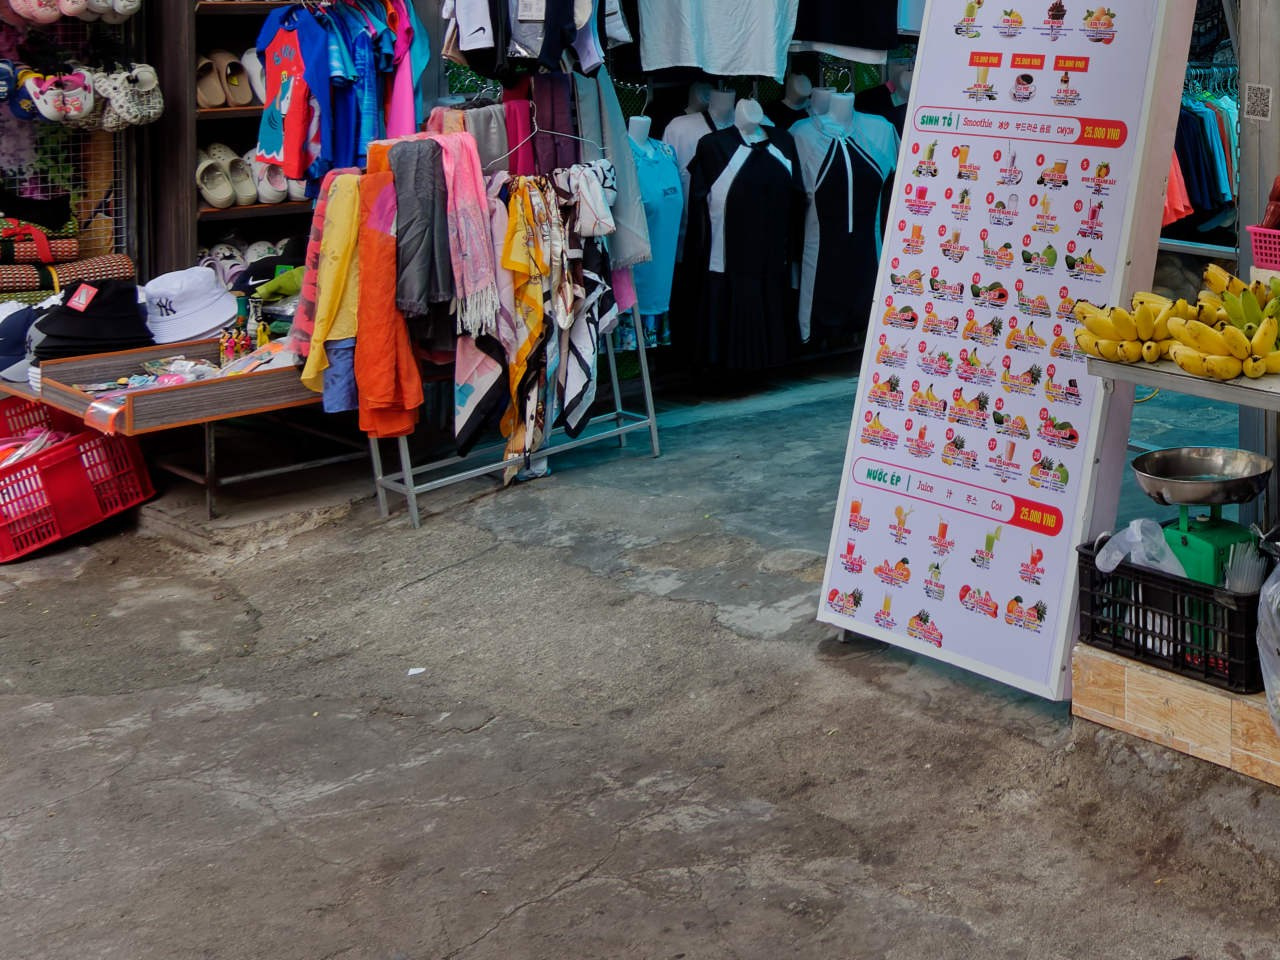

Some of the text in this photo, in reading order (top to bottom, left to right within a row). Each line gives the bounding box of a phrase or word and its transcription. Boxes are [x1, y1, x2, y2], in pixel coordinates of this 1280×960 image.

[919, 111, 993, 128] SINH TỐ Smoothie
[890, 470, 902, 487] ÉP
[915, 480, 934, 494] Juice
[1019, 506, 1041, 524] 25.000
